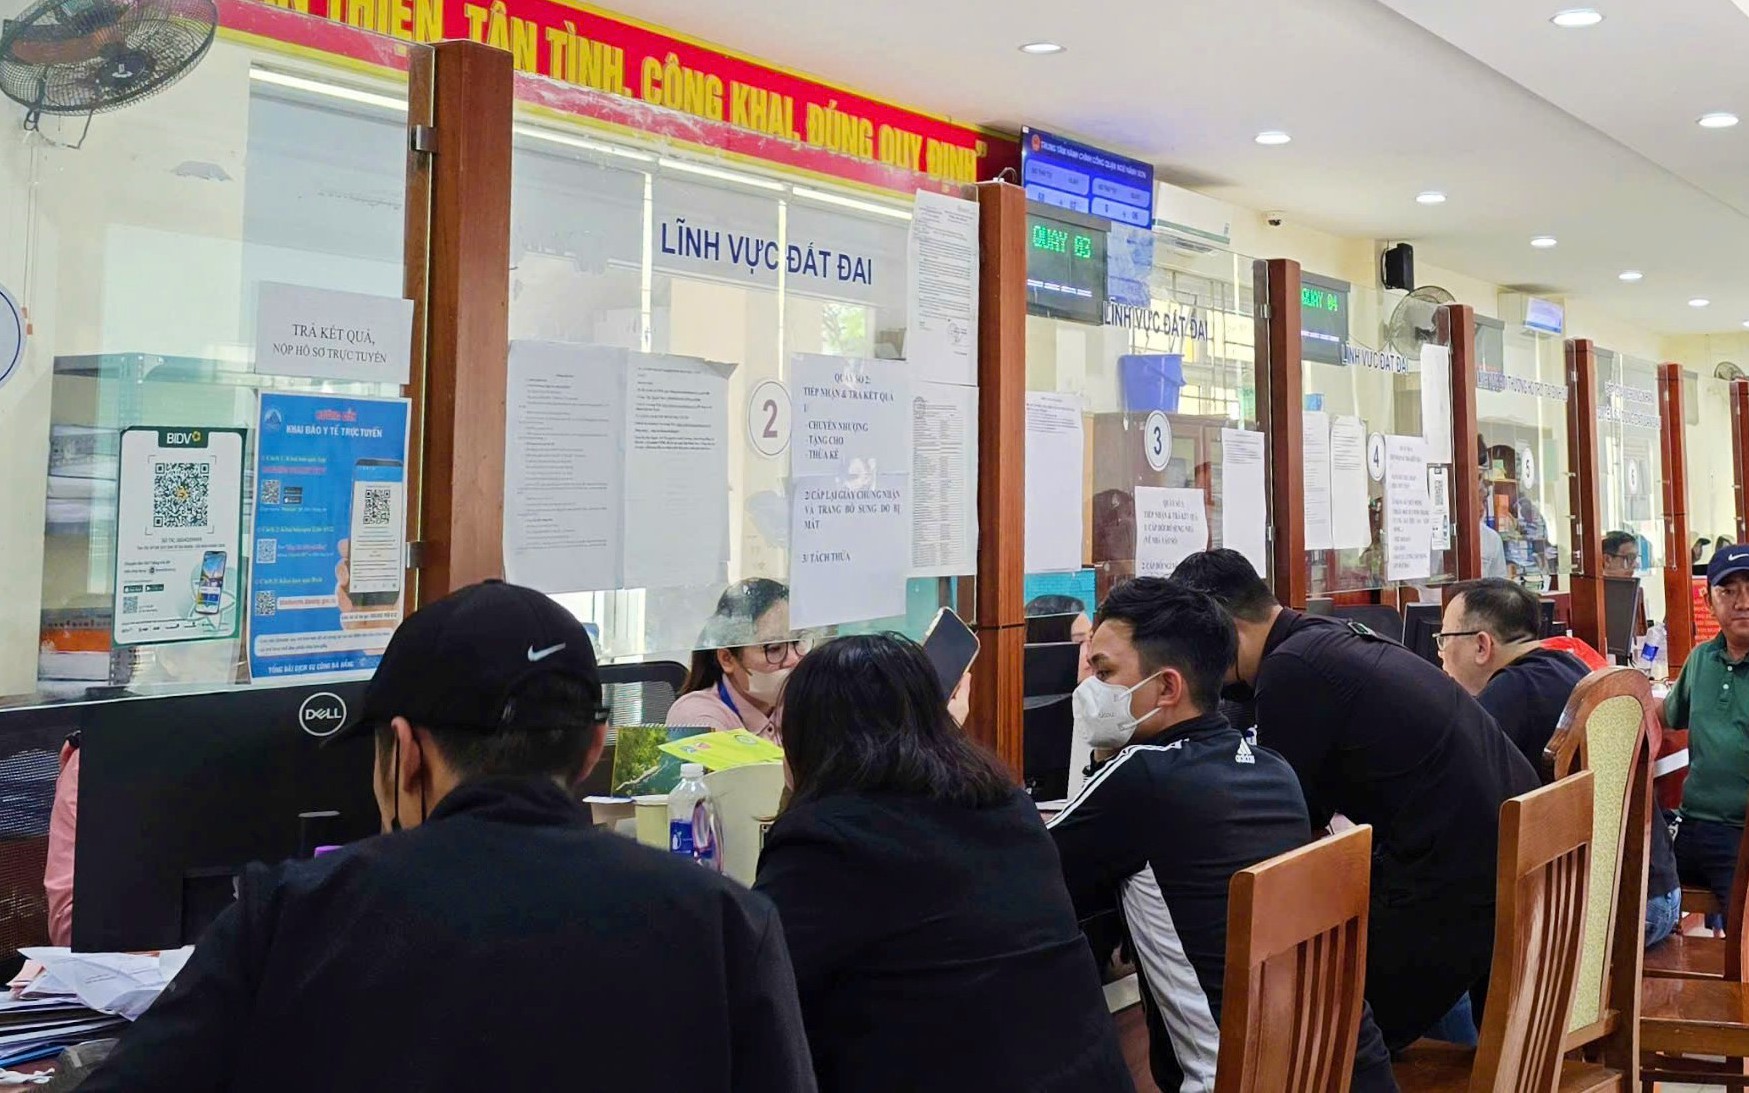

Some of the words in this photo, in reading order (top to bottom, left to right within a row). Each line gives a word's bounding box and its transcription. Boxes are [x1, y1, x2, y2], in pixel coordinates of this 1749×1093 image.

[641, 52, 724, 122] CÔNG
[806, 99, 874, 161] ĐÚNG
[878, 123, 927, 172] QUY
[661, 218, 720, 261] LĨNH
[727, 233, 779, 275] VỰC
[786, 241, 832, 278] ĐẤT
[837, 253, 872, 285] ĐAI
[1074, 235, 1091, 259] 03
[1327, 293, 1339, 312] 04
[1102, 298, 1132, 329] LĨNH
[1135, 308, 1160, 336] VỰC
[1163, 309, 1186, 338] ĐẤT
[1190, 317, 1208, 342] ĐAI
[292, 321, 317, 338] TRẢ
[320, 324, 344, 341] KẾT
[346, 328, 376, 346] QUẢ,
[272, 342, 294, 356] NỘP
[295, 343, 310, 357] HỒ
[312, 346, 325, 358] SƠ
[326, 347, 355, 362] TRỰC
[355, 349, 387, 363] TUYẾN
[803, 386, 819, 397] TIẾP
[820, 387, 840, 400] NHẬN
[841, 389, 847, 399] &
[863, 389, 878, 400] KẾT
[762, 398, 778, 438] 2
[808, 418, 837, 431] CHUYỂN
[838, 421, 869, 433] NHƯỢNG
[166, 432, 192, 445] BIDV
[286, 424, 304, 434] KHAI
[305, 424, 321, 435] BÁO
[323, 426, 328, 435] Y
[329, 424, 340, 436] TẾ
[341, 426, 360, 438] TRỰC
[360, 425, 383, 438] TUYẾN
[828, 435, 844, 445] CHO
[1153, 426, 1162, 455] 3
[1373, 445, 1380, 468] 4
[1525, 459, 1531, 478] 5
[818, 504, 841, 514] TRANG
[858, 504, 877, 513] SUNG
[305, 708, 342, 720] DELL
